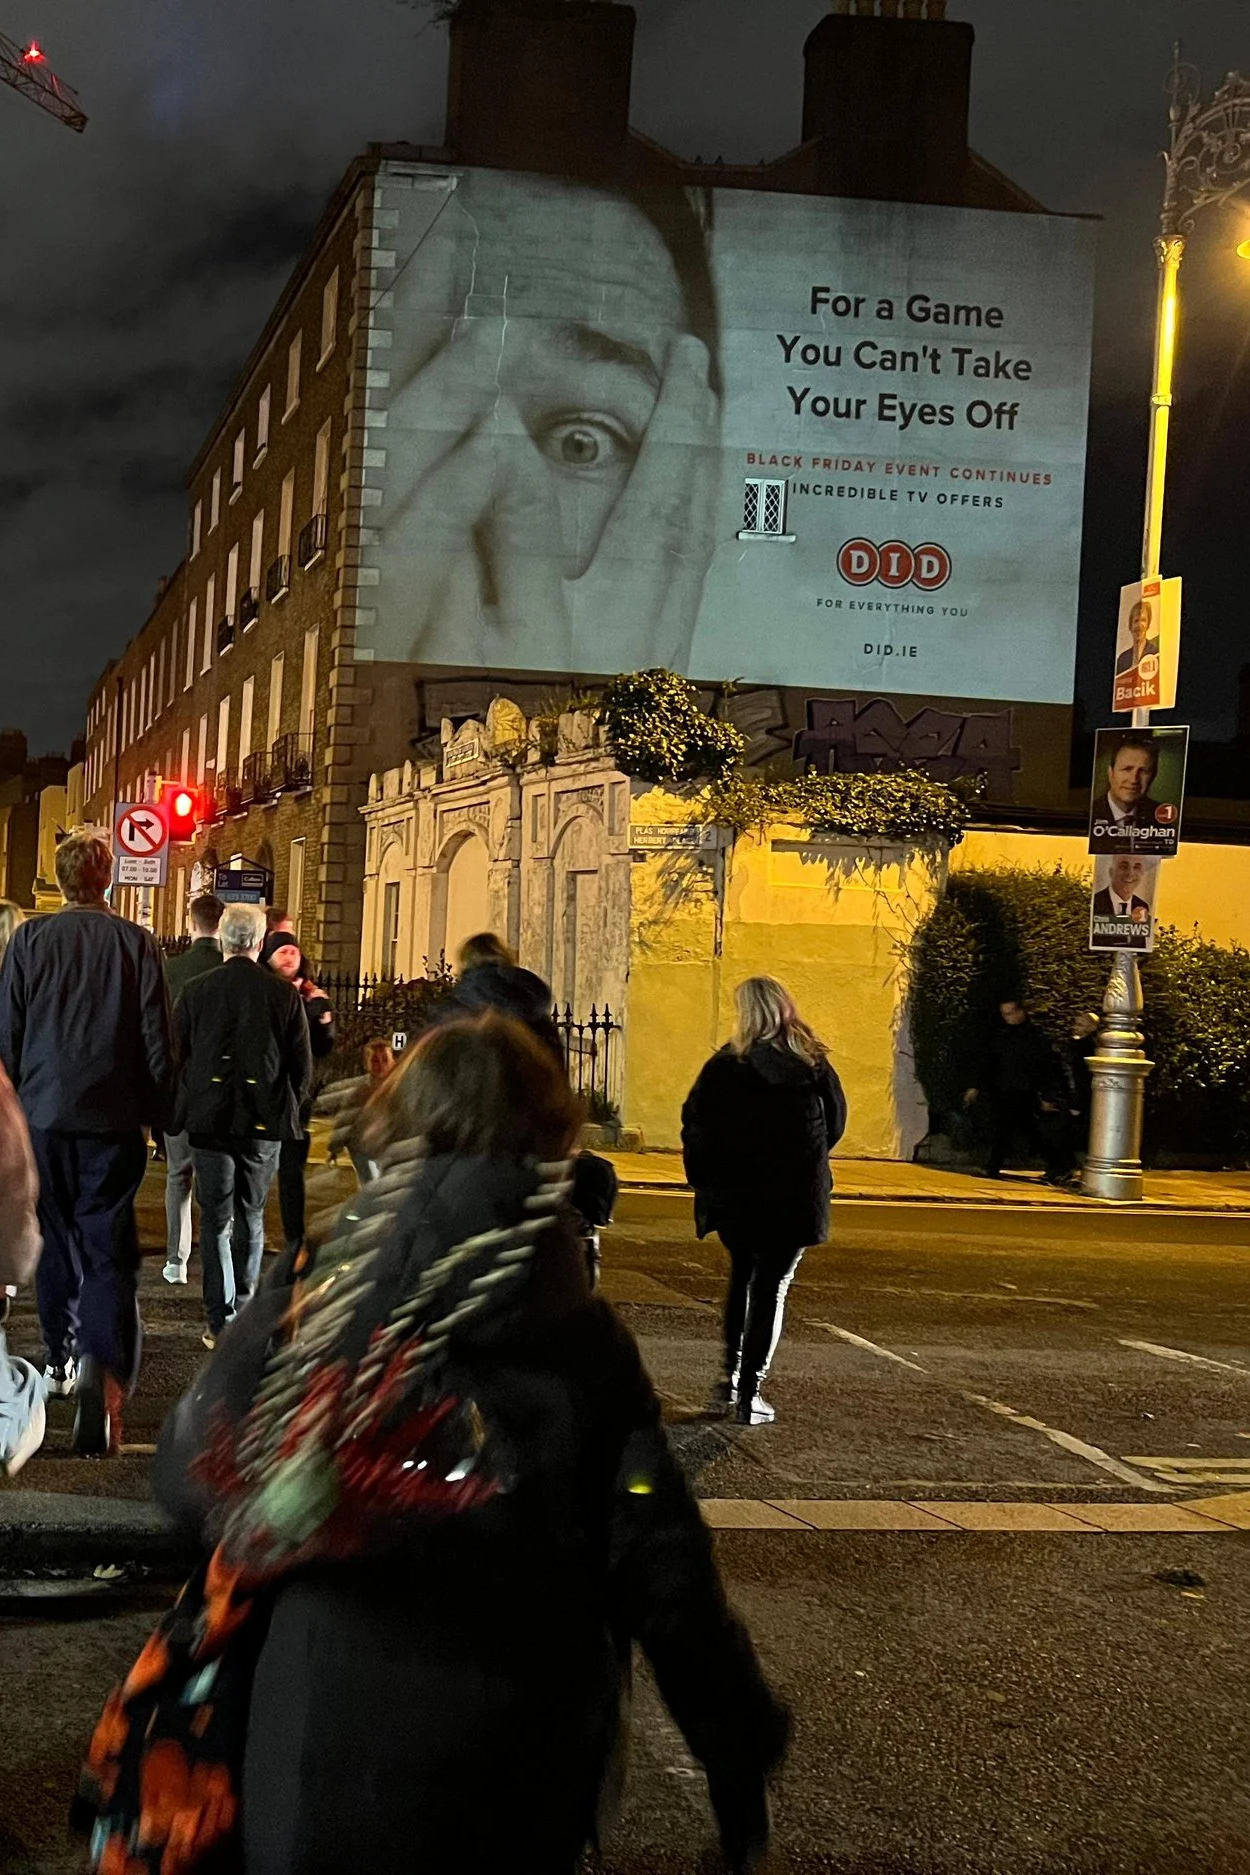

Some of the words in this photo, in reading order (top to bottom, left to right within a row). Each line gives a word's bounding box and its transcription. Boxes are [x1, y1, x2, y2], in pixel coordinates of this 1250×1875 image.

[810, 286, 866, 318] For
[875, 298, 894, 320] a
[906, 294, 1004, 329] Game
[776, 334, 842, 367] You
[853, 340, 941, 375] Can't
[951, 347, 1033, 381] Take
[786, 386, 867, 420] Your
[878, 393, 955, 431] Eyes
[966, 399, 1020, 431] Off
[746, 452, 803, 469] BLACK
[811, 457, 876, 474] FRIDAY
[885, 462, 941, 479] EVENT
[949, 467, 1053, 486] CONTINUES
[792, 482, 899, 502] INCREDIBLE
[906, 490, 928, 504] TV
[936, 493, 1005, 508] OFFERS
[816, 598, 843, 609] FOR
[849, 600, 935, 615] EVERYTHING
[941, 607, 969, 617] YOU
[863, 643, 918, 658] DID.IE
[1115, 680, 1157, 701] Bacik
[1165, 806, 1173, 819] 1
[1092, 825, 1176, 840] O'Callaghan
[1093, 923, 1150, 937] ANDREWS
[395, 1035, 404, 1048] H
